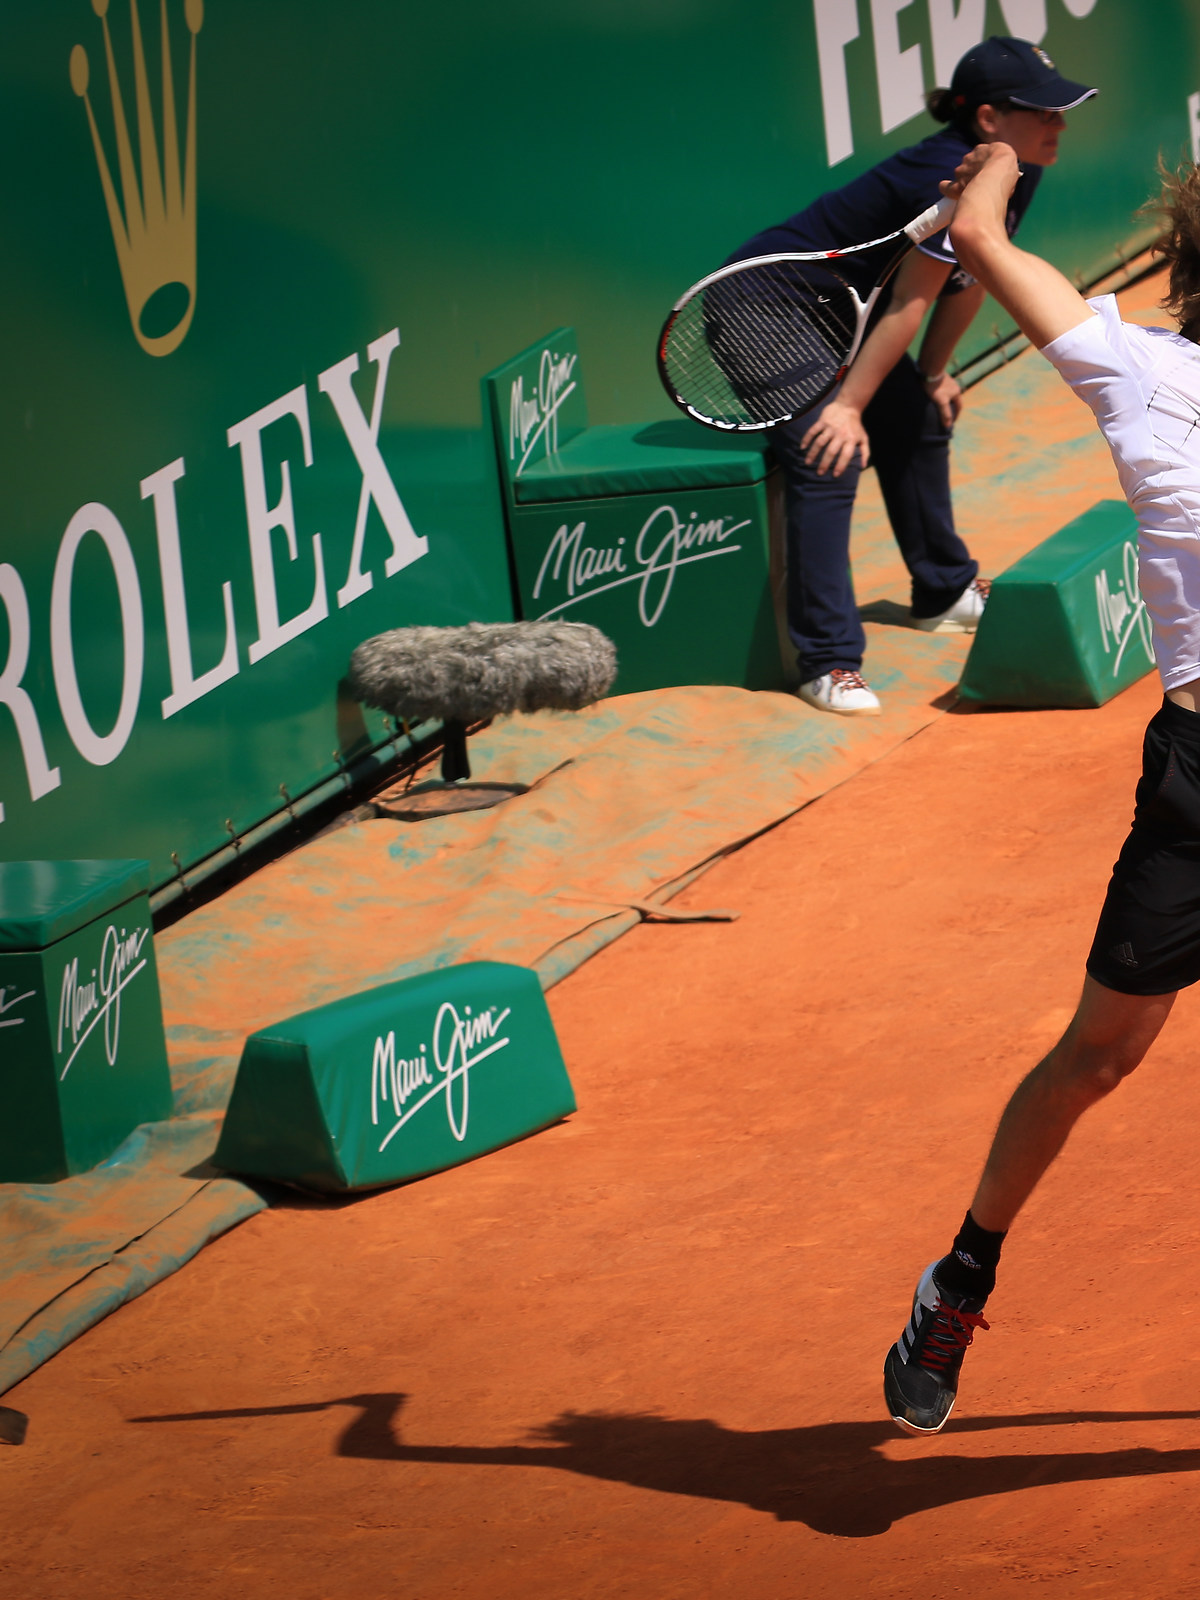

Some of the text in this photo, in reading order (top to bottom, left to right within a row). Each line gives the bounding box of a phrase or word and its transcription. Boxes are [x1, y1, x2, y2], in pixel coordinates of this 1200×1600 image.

[532, 505, 752, 627] Maui Jim
[57, 925, 149, 1066] Maui Jim
[371, 1002, 511, 1141] Maui Jim
